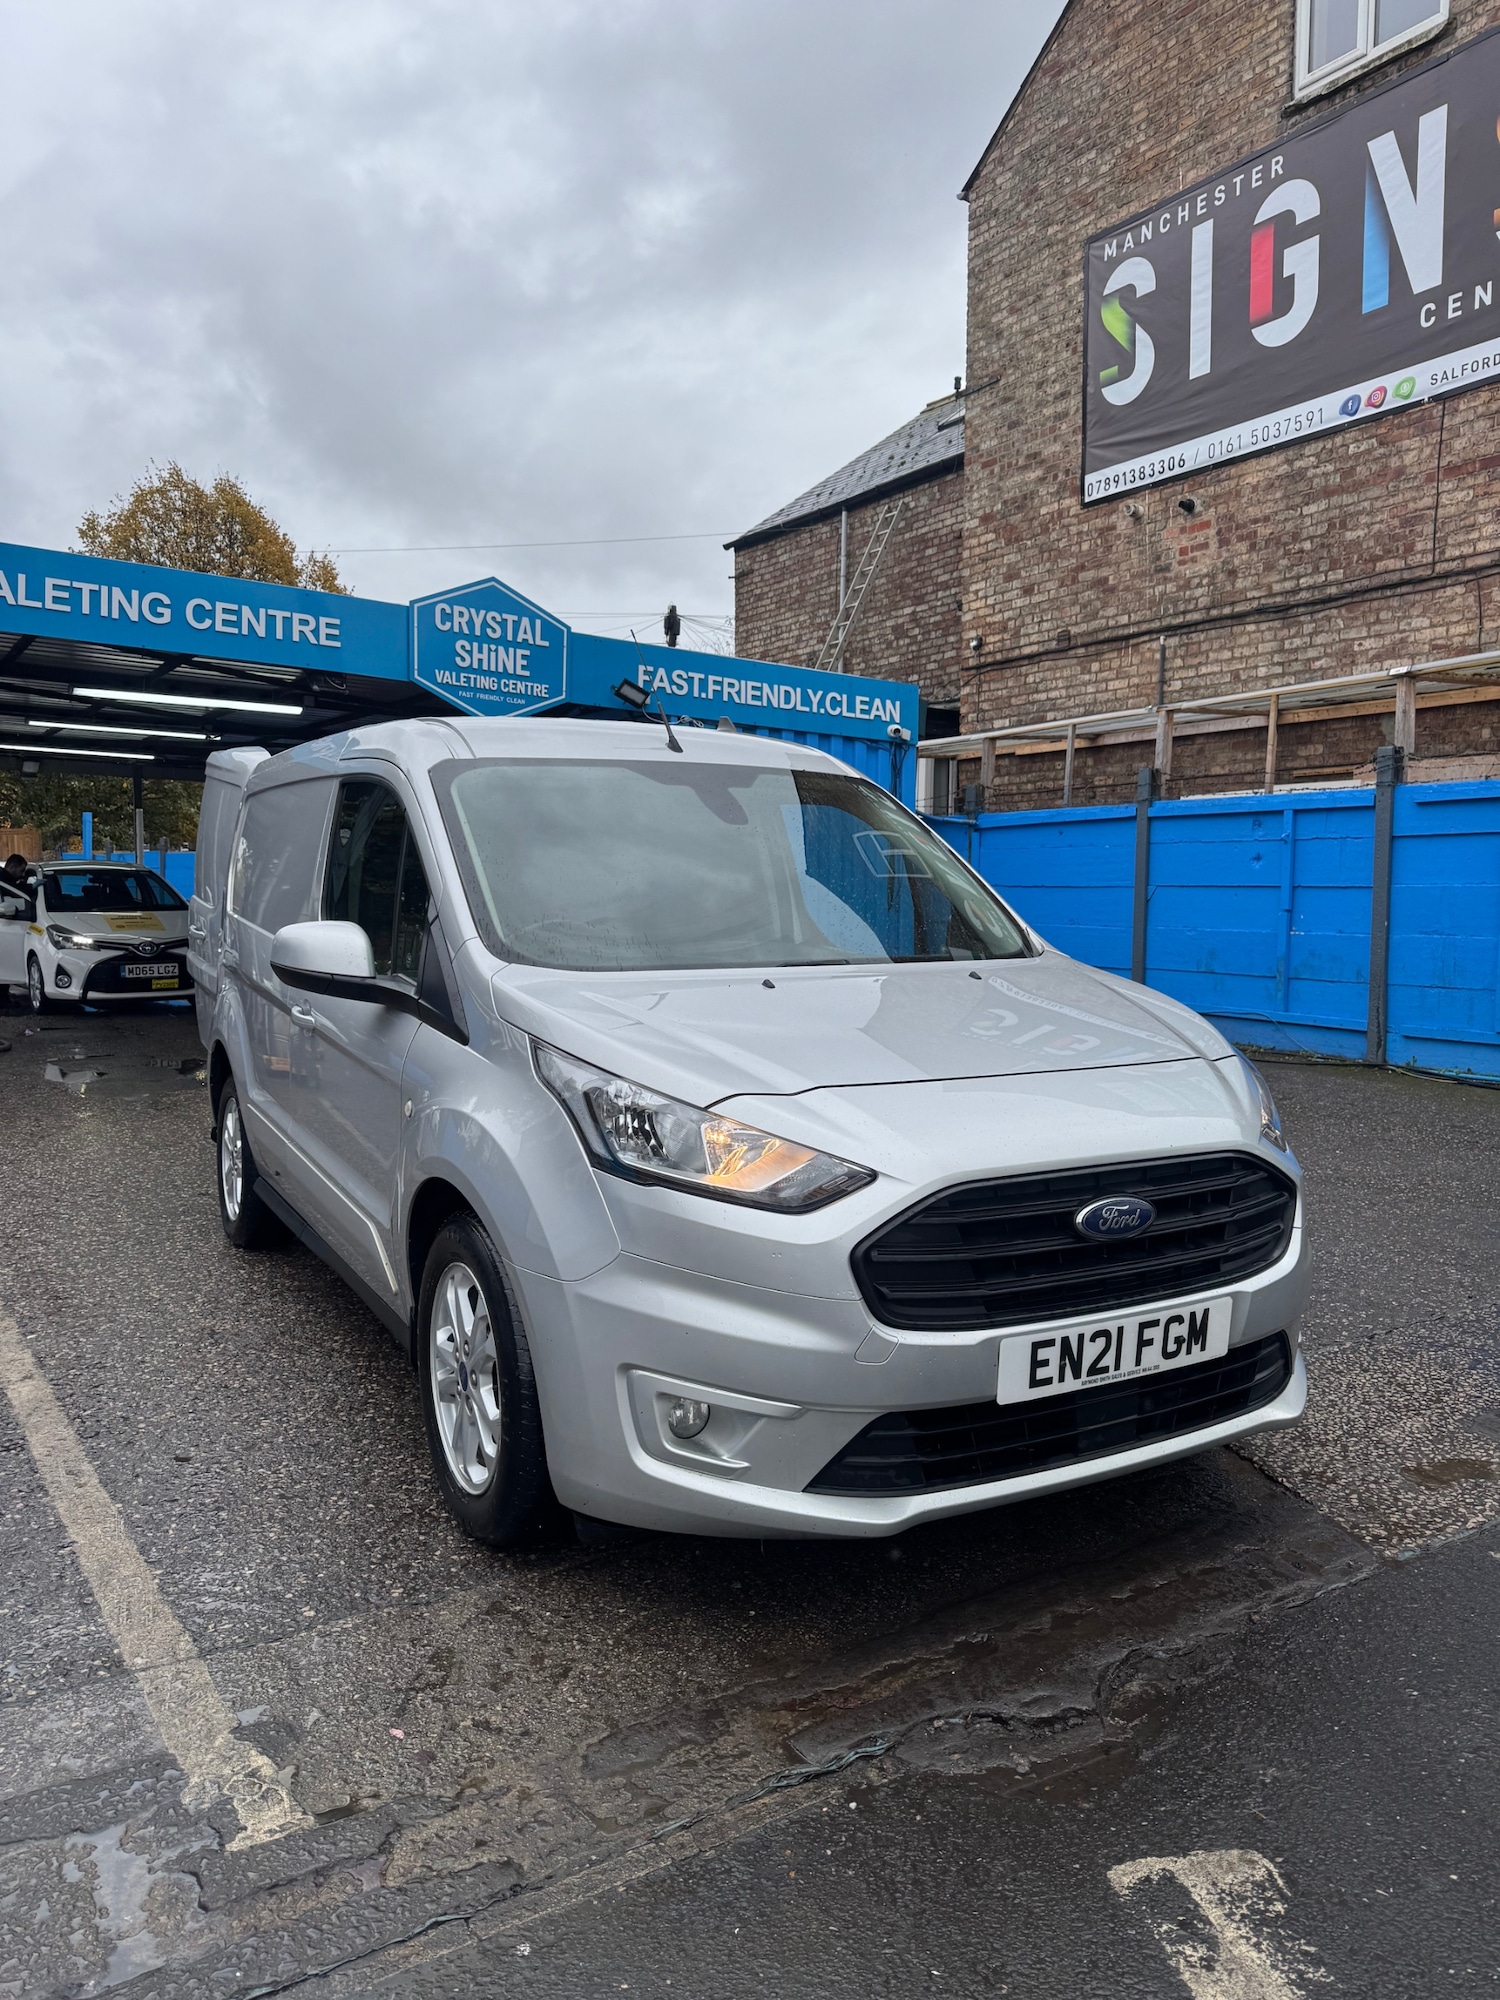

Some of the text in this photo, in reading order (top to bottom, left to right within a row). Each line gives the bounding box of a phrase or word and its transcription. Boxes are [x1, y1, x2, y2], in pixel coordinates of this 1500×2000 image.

[1103, 155, 1285, 262] MANCHESTER
[1100, 103, 1500, 406] SIGN
[1420, 280, 1493, 328] CEN
[1086, 452, 1186, 498] 07891383306
[1208, 434, 1243, 459] 0161
[1250, 407, 1324, 446] 5037591
[1430, 353, 1500, 386] SALFORD
[185, 598, 342, 648] CENTRE
[435, 602, 550, 647] CRYSTAL
[435, 669, 549, 698] VALETING CENTRE
[476, 693, 504, 702] FRIENDLY
[506, 696, 526, 704] CLEAN
[1099, 1205, 1141, 1231] Ford
[1028, 1307, 1210, 1389] EN21 FGM
